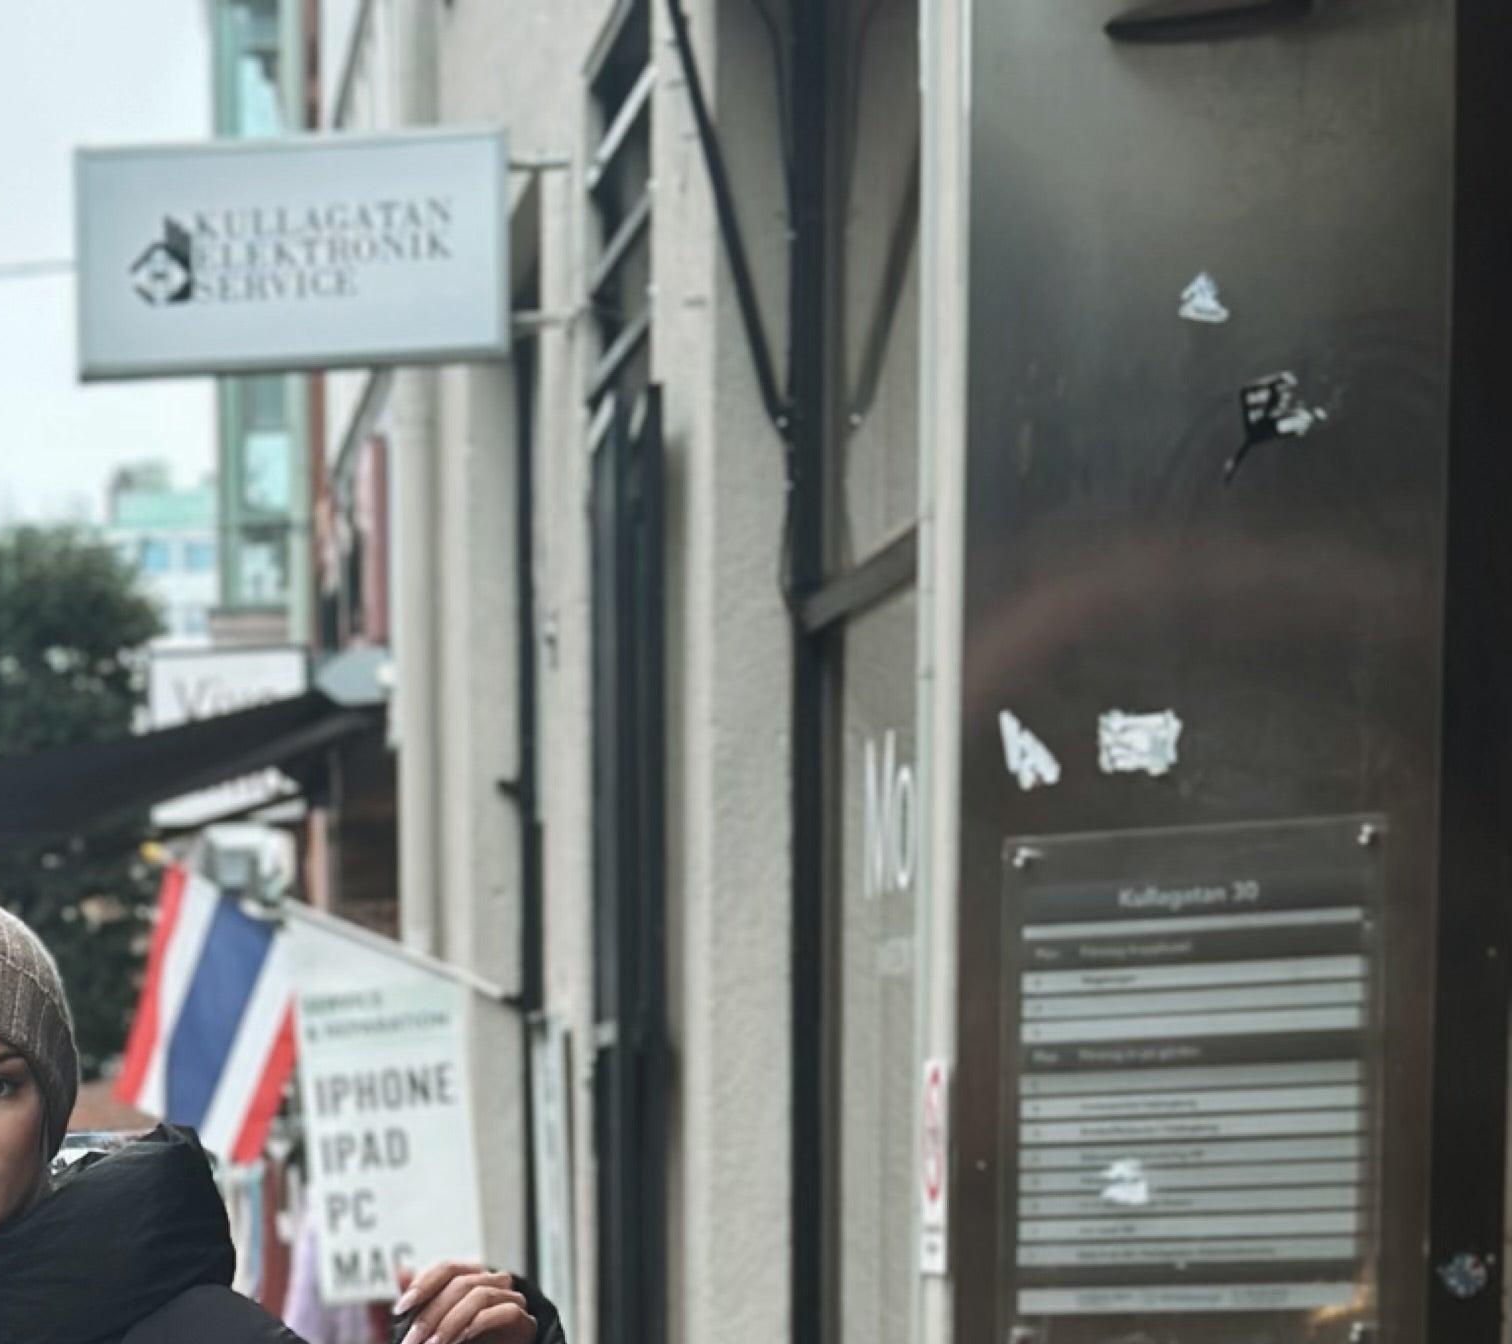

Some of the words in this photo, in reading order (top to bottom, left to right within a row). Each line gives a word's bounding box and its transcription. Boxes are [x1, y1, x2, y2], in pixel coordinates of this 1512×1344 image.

[194, 198, 453, 238] KULLAGATAN
[194, 233, 453, 269] ELEKTRONIK
[192, 268, 359, 301] SERVICE
[314, 1062, 456, 1118] IPHONE
[320, 1126, 410, 1174] IPAD
[326, 1189, 377, 1235] PC
